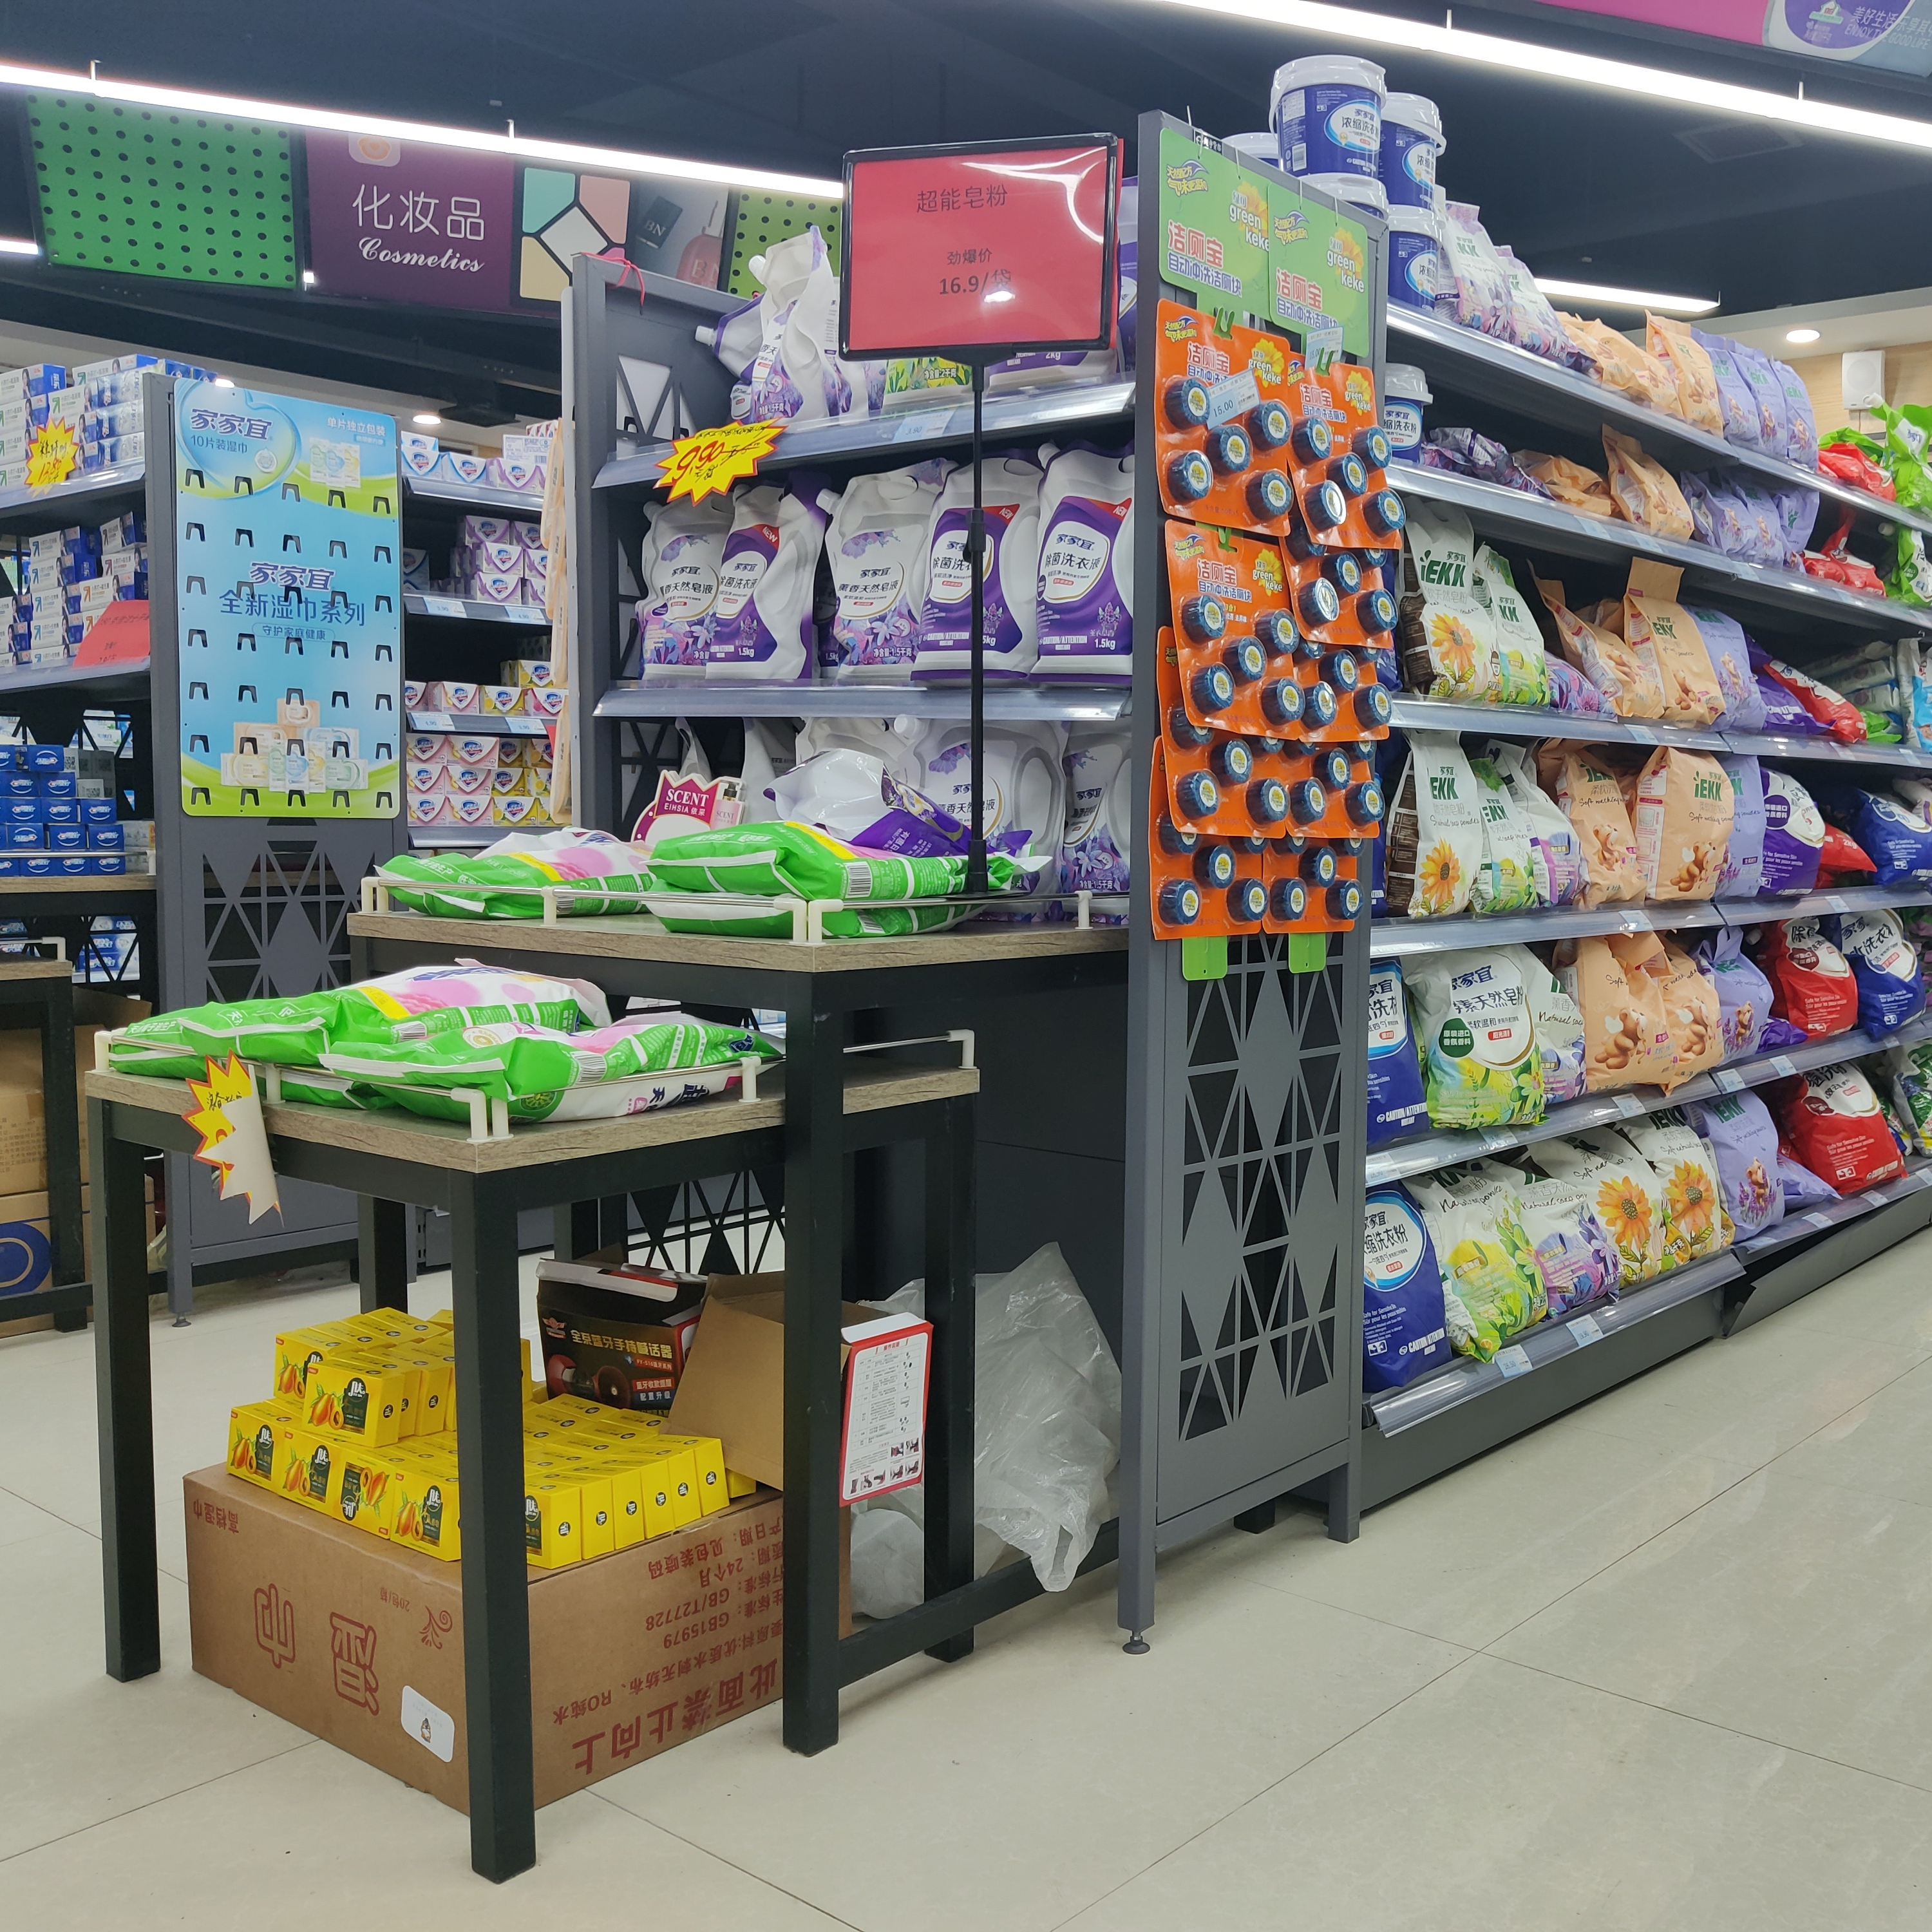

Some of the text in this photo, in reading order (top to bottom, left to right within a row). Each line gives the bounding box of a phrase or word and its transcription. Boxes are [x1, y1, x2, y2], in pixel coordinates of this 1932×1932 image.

[1845, 24, 1871, 39] ENJOY
[1888, 32, 1911, 47] GOOD
[1911, 37, 1931, 50] LIFE
[916, 184, 1009, 214] 超能皂粉
[352, 184, 485, 242] 化妆品
[1229, 202, 1262, 231] green
[644, 220, 667, 237] BN
[1168, 220, 1224, 269] 洁厕宝
[1245, 229, 1269, 252] keke
[358, 236, 486, 273] Cosmetics
[947, 247, 993, 266] 劲爆价
[1327, 249, 1356, 275] green
[1168, 252, 1242, 298] 自动冲洗洁厕块
[1340, 273, 1365, 293] keke
[1276, 267, 1323, 312] 洁厕宝
[1187, 341, 1230, 375] 洁厕宝
[1247, 358, 1272, 373] green
[1187, 364, 1229, 383] 自动冲洗
[1262, 370, 1282, 385] keke
[1300, 383, 1334, 408] 洁厕宝
[1345, 390, 1363, 402] green
[1213, 399, 1235, 418] 15.00
[1356, 400, 1371, 412] keke
[190, 408, 273, 441] 家家宜
[327, 416, 386, 437] 单片独立包装
[1383, 419, 1417, 435] 缩洗衣粉
[190, 434, 248, 454] 10片装湿巾
[998, 507, 1014, 520] NEW
[1112, 505, 1128, 517] NEW
[761, 526, 779, 544] NEW
[1057, 533, 1096, 551] 家家宜
[946, 540, 968, 552] 家家
[933, 556, 972, 572] 除菌洗
[1044, 551, 1102, 571] 除菌洗衣液
[249, 562, 336, 591] 家家宜
[859, 566, 891, 579] 家家宜
[1197, 558, 1238, 587] 洁厕宝
[1252, 569, 1274, 581] green
[1419, 555, 1466, 588] iEKK
[837, 580, 900, 594] 薰香天然皂液
[1198, 580, 1252, 603] 自动冲洗洁厕块
[1265, 579, 1283, 592] keke
[1423, 585, 1468, 605] 软天然皂粉
[219, 589, 366, 627] 全新湿巾系列
[1498, 604, 1520, 623] KK
[261, 625, 327, 641] 守护家庭健康
[738, 647, 755, 658] 1.5kg
[1094, 638, 1116, 650] 1.5kg
[665, 788, 710, 808] SCENT
[952, 784, 973, 795] 家家
[1429, 776, 1459, 800] EKK
[1694, 775, 1722, 802] iEKK
[663, 802, 690, 815] EIHSIA
[715, 810, 735, 820] SCENT
[1539, 1011, 1571, 1026] Natural
[1363, 1223, 1409, 1255] 缩洗衣粉
[192, 1499, 240, 1535] 高档湿巾
[253, 1583, 380, 1716] 湿巾
[571, 1658, 778, 1776] 此面禁止向上
